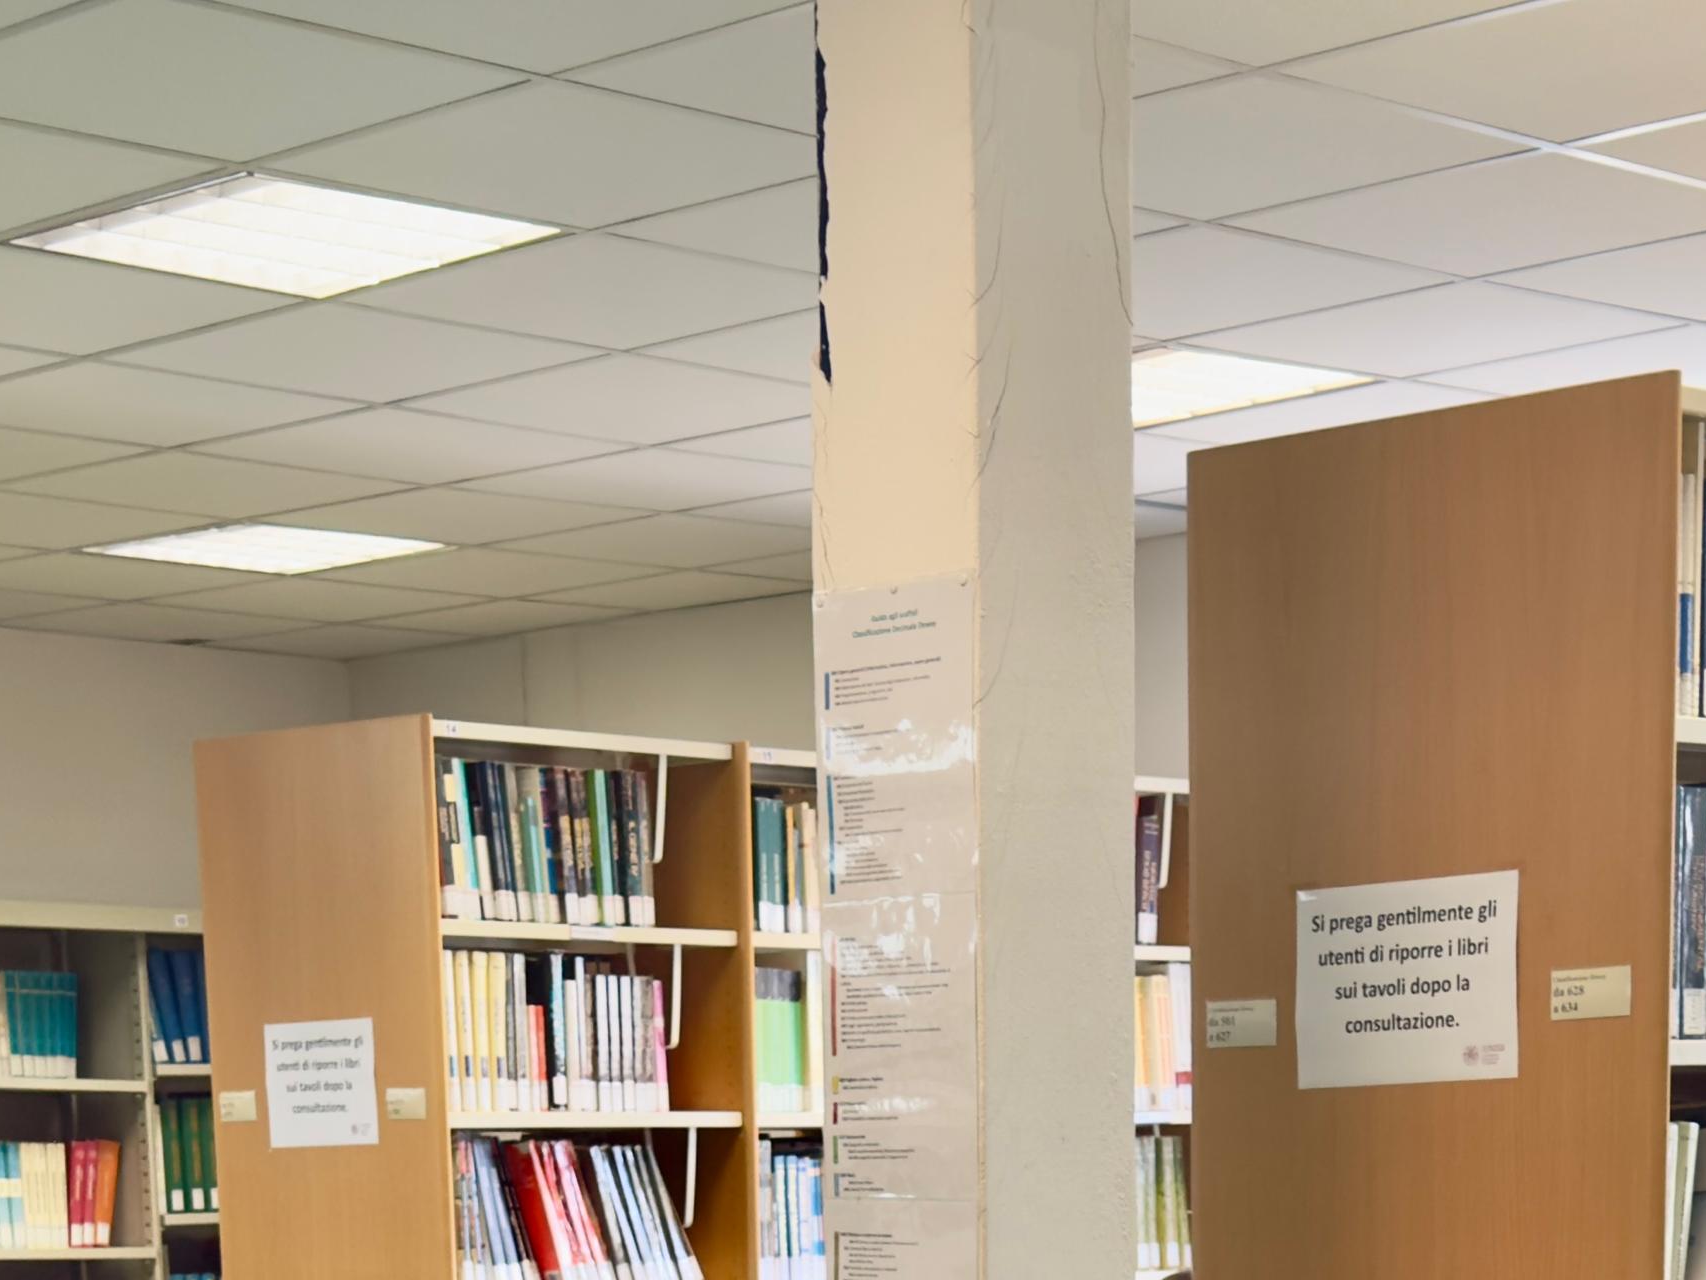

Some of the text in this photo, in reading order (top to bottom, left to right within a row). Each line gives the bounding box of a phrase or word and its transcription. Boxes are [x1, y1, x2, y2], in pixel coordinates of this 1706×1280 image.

[1311, 899, 1498, 936] Si prega gentilmente gli
[1318, 946, 1366, 967] utenti
[1369, 944, 1384, 964] di
[1388, 942, 1443, 965] riporre
[1457, 935, 1489, 956] libri
[1335, 974, 1471, 1000] sui tavoli dopo la
[1554, 986, 1564, 997] da
[1345, 1011, 1460, 1035] consultazione.
[281, 1040, 303, 1053] prega
[305, 1036, 352, 1052] gentilmente
[311, 1060, 338, 1073] riporre
[345, 1057, 360, 1070] libri
[286, 1082, 298, 1093] sui
[300, 1080, 321, 1092] tavoli
[323, 1080, 344, 1094] dopo
